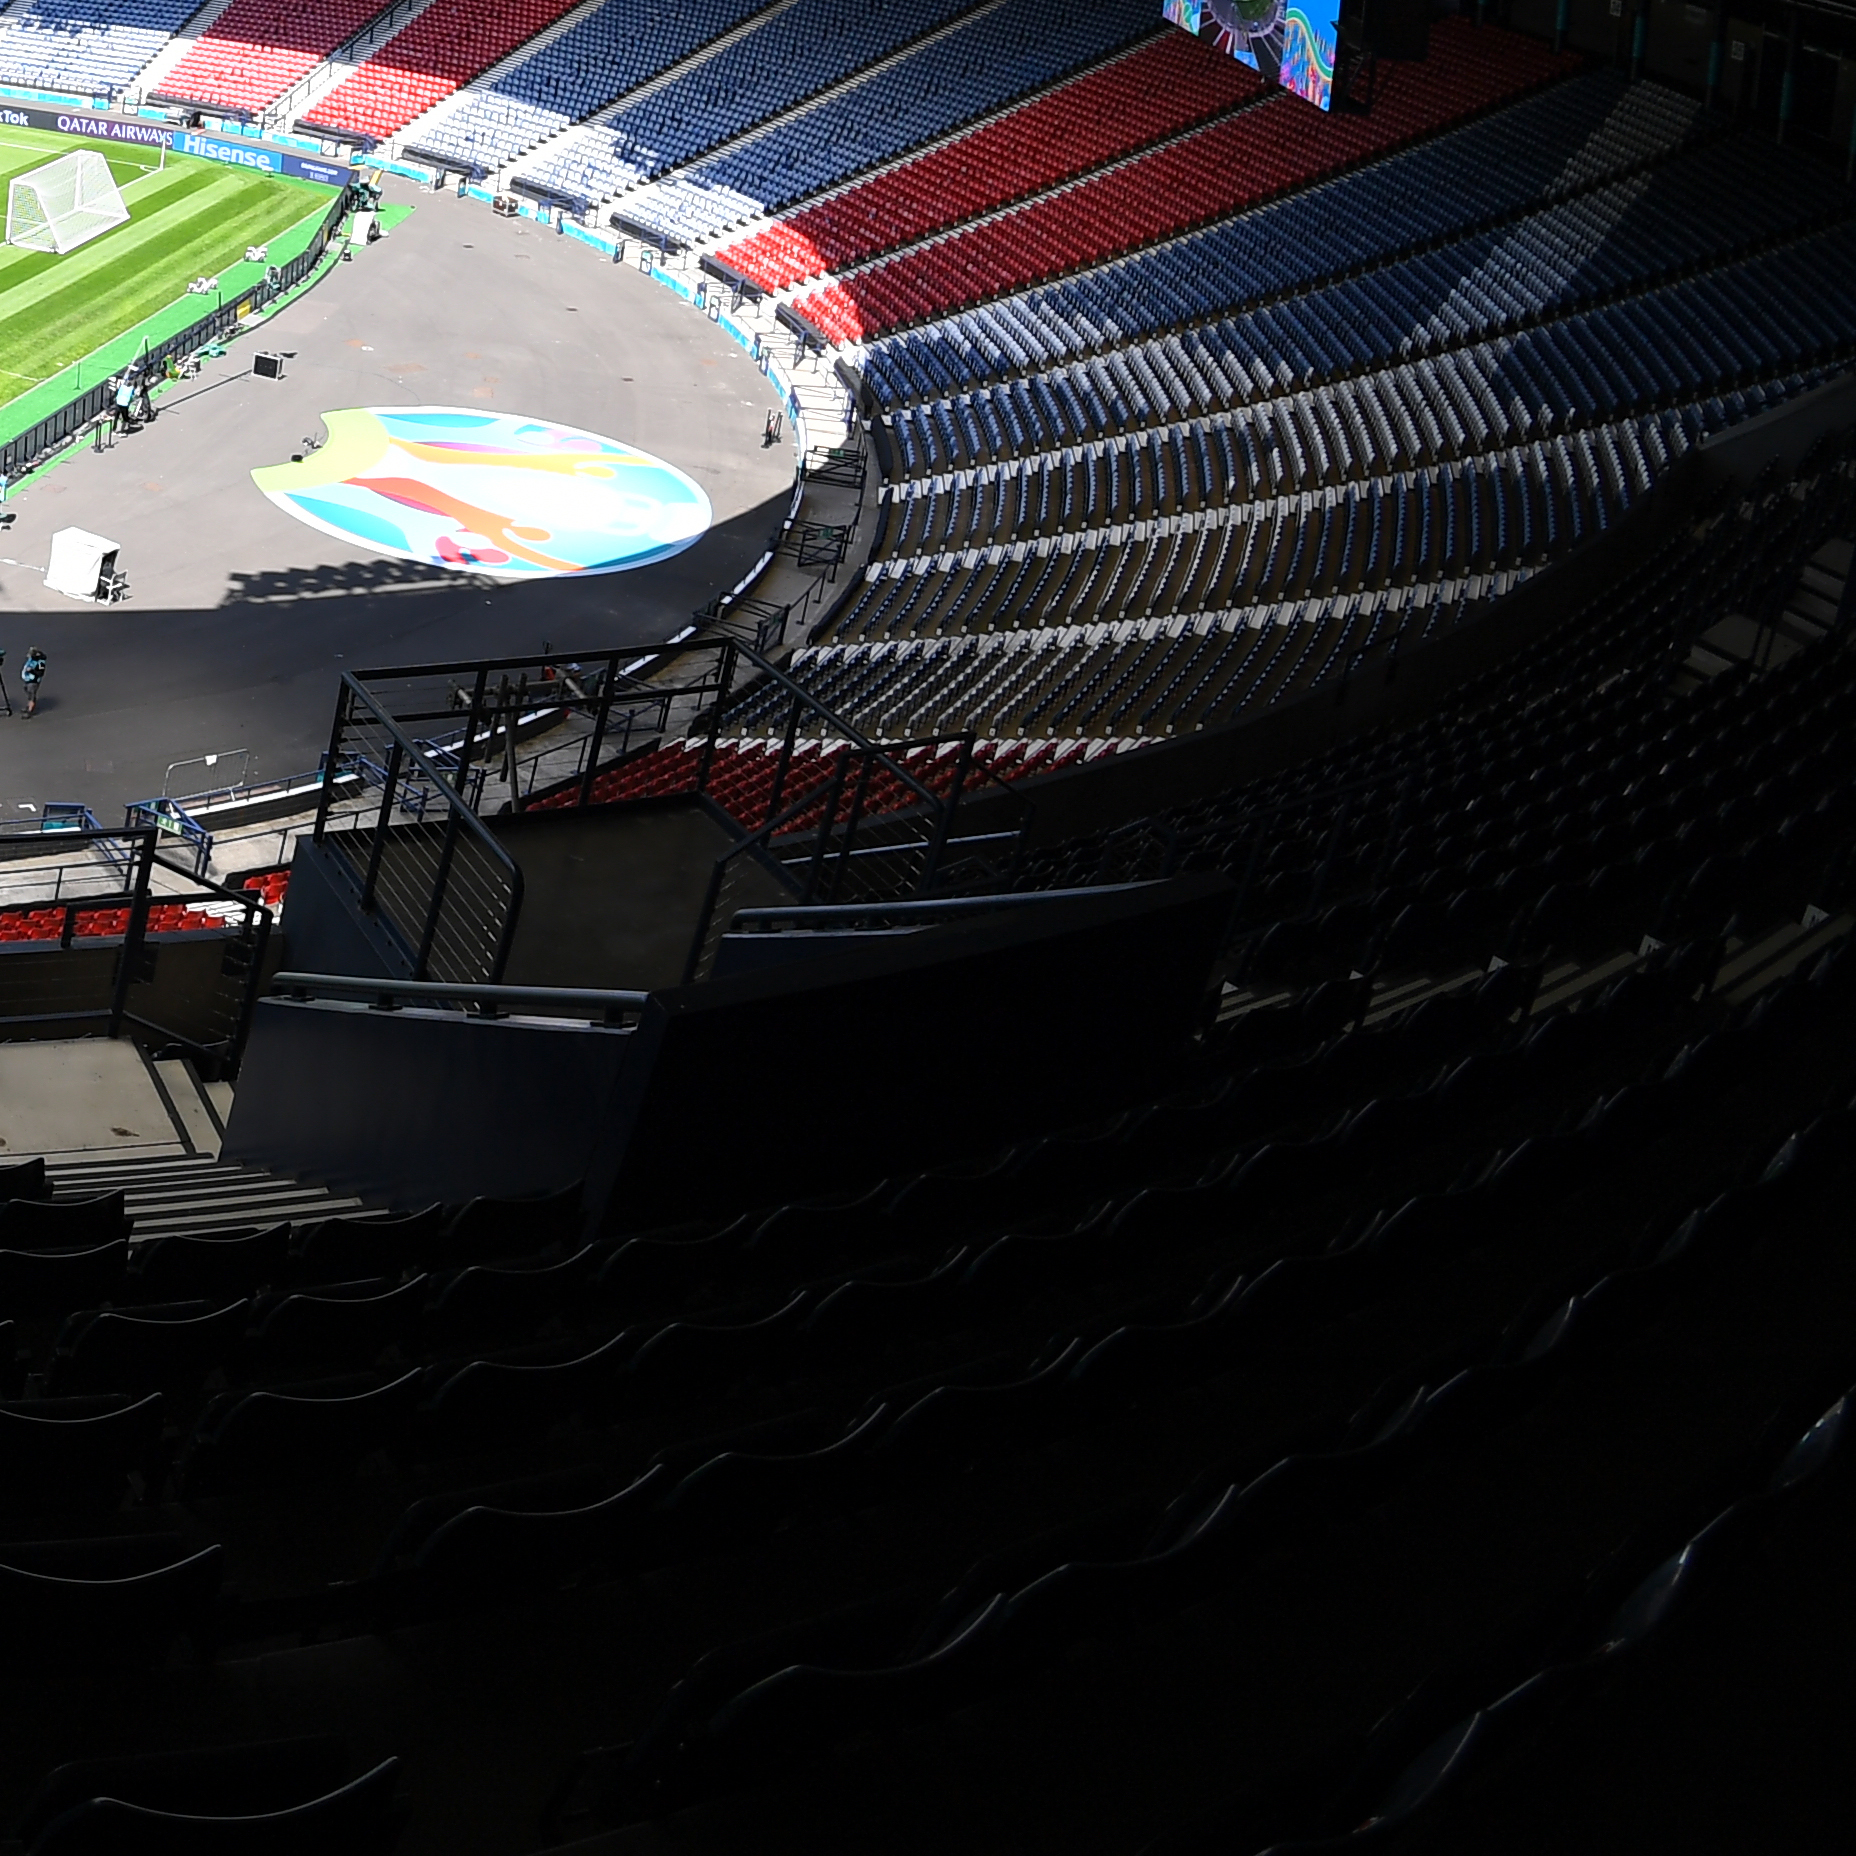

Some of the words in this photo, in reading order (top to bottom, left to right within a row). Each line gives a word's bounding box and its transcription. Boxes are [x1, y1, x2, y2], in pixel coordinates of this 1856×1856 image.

[57, 115, 108, 135] QATAR
[112, 123, 173, 146] AIRWAYS
[184, 135, 271, 168] Hisense
